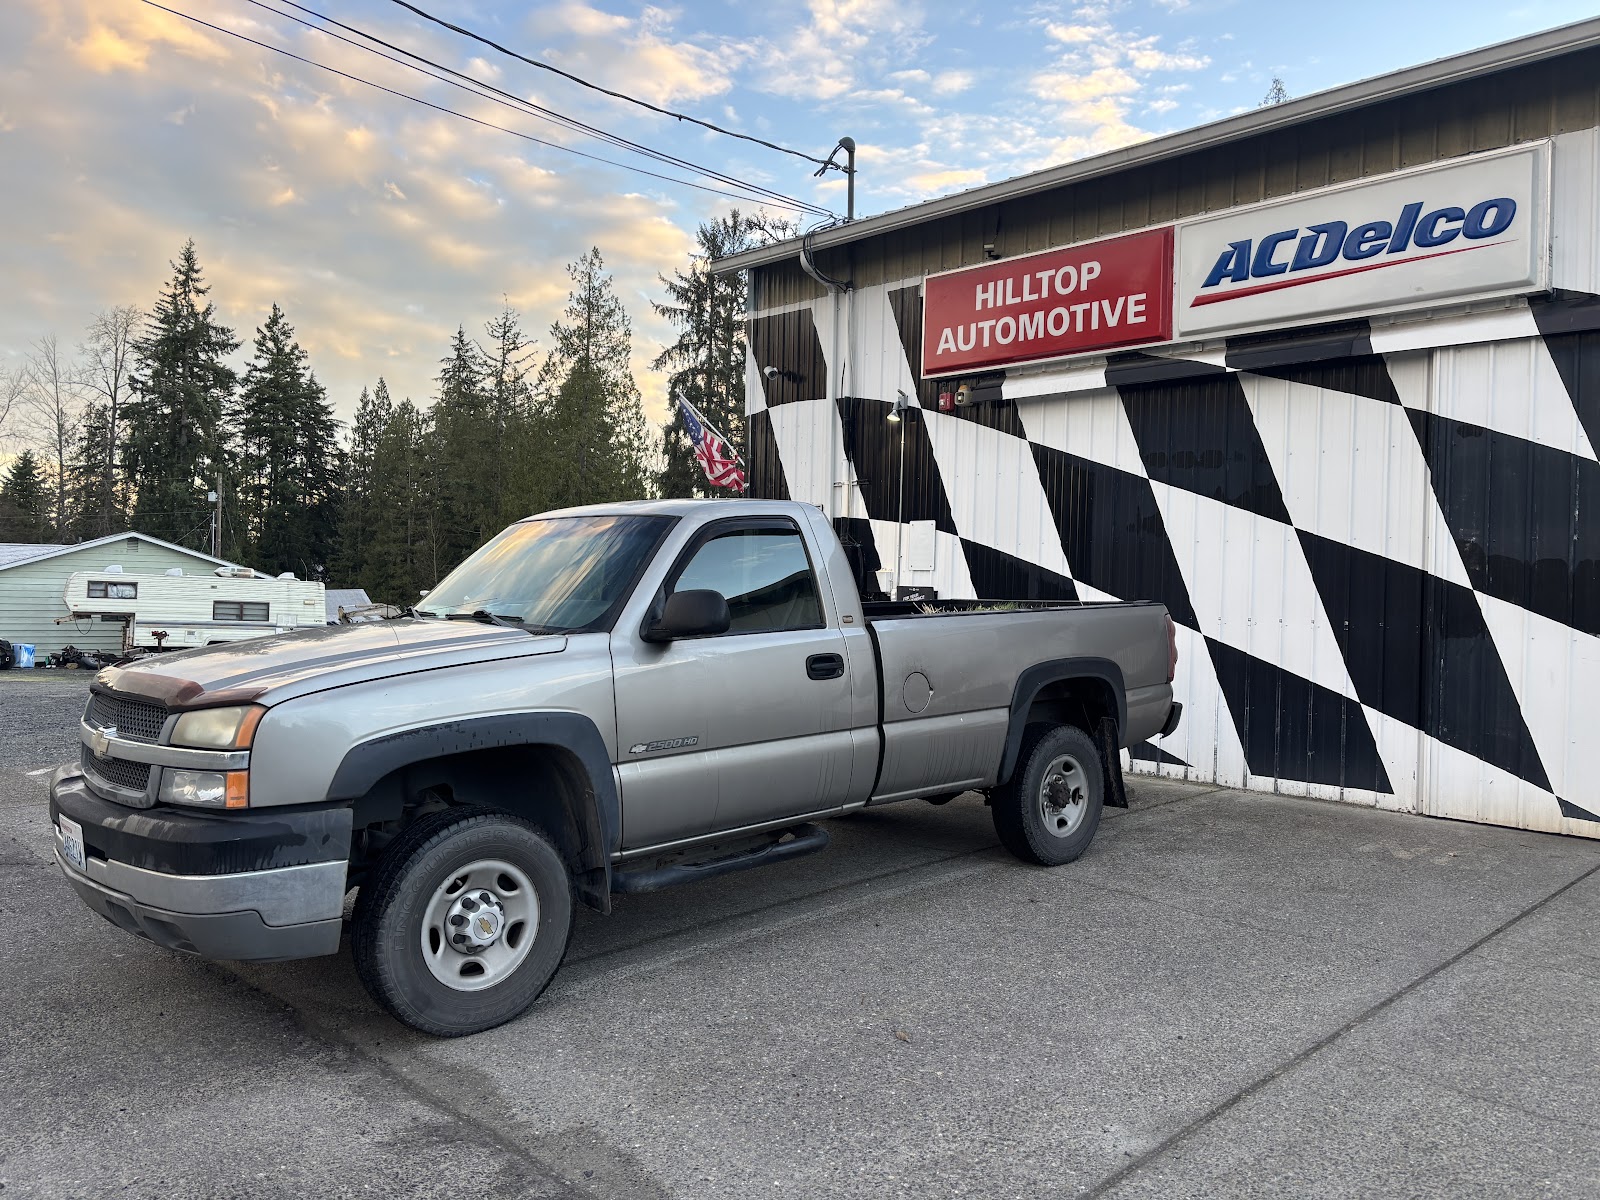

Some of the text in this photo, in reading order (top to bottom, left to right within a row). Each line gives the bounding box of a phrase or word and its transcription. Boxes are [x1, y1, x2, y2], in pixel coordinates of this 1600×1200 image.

[1203, 197, 1517, 288] ACDelco
[975, 260, 1102, 311] HILLTOP
[936, 293, 1147, 355] AUTOMOTIVE
[648, 737, 698, 751] 2500 HD
[394, 829, 545, 952] ENCOUNTER HT
